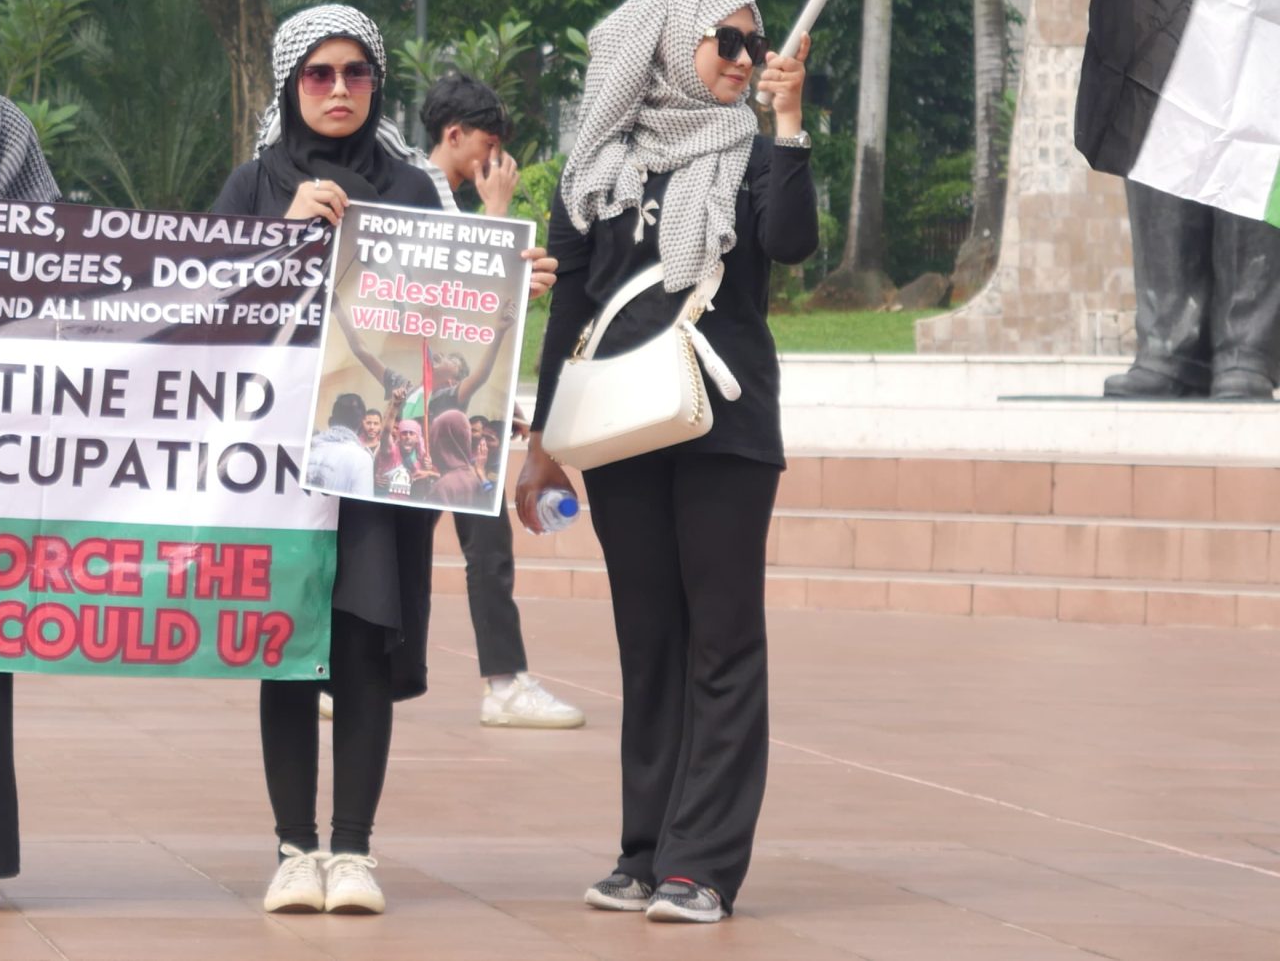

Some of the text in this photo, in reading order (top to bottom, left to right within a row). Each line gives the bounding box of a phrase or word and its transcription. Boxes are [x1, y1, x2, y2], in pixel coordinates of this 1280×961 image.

[83, 209, 332, 247] JOURNALISTS,
[359, 214, 515, 248] FROM THE RIVER
[153, 258, 330, 295] DOCTORS,
[357, 238, 506, 278] TO THE SEA
[358, 271, 500, 312] Palestine
[38, 299, 85, 321] ALL
[93, 301, 229, 326] INNOCENT
[233, 304, 321, 327] PEOPLE
[352, 306, 495, 344] Will Be Free
[153, 370, 275, 422] END
[157, 540, 272, 601] THE
[217, 609, 295, 668] U?
